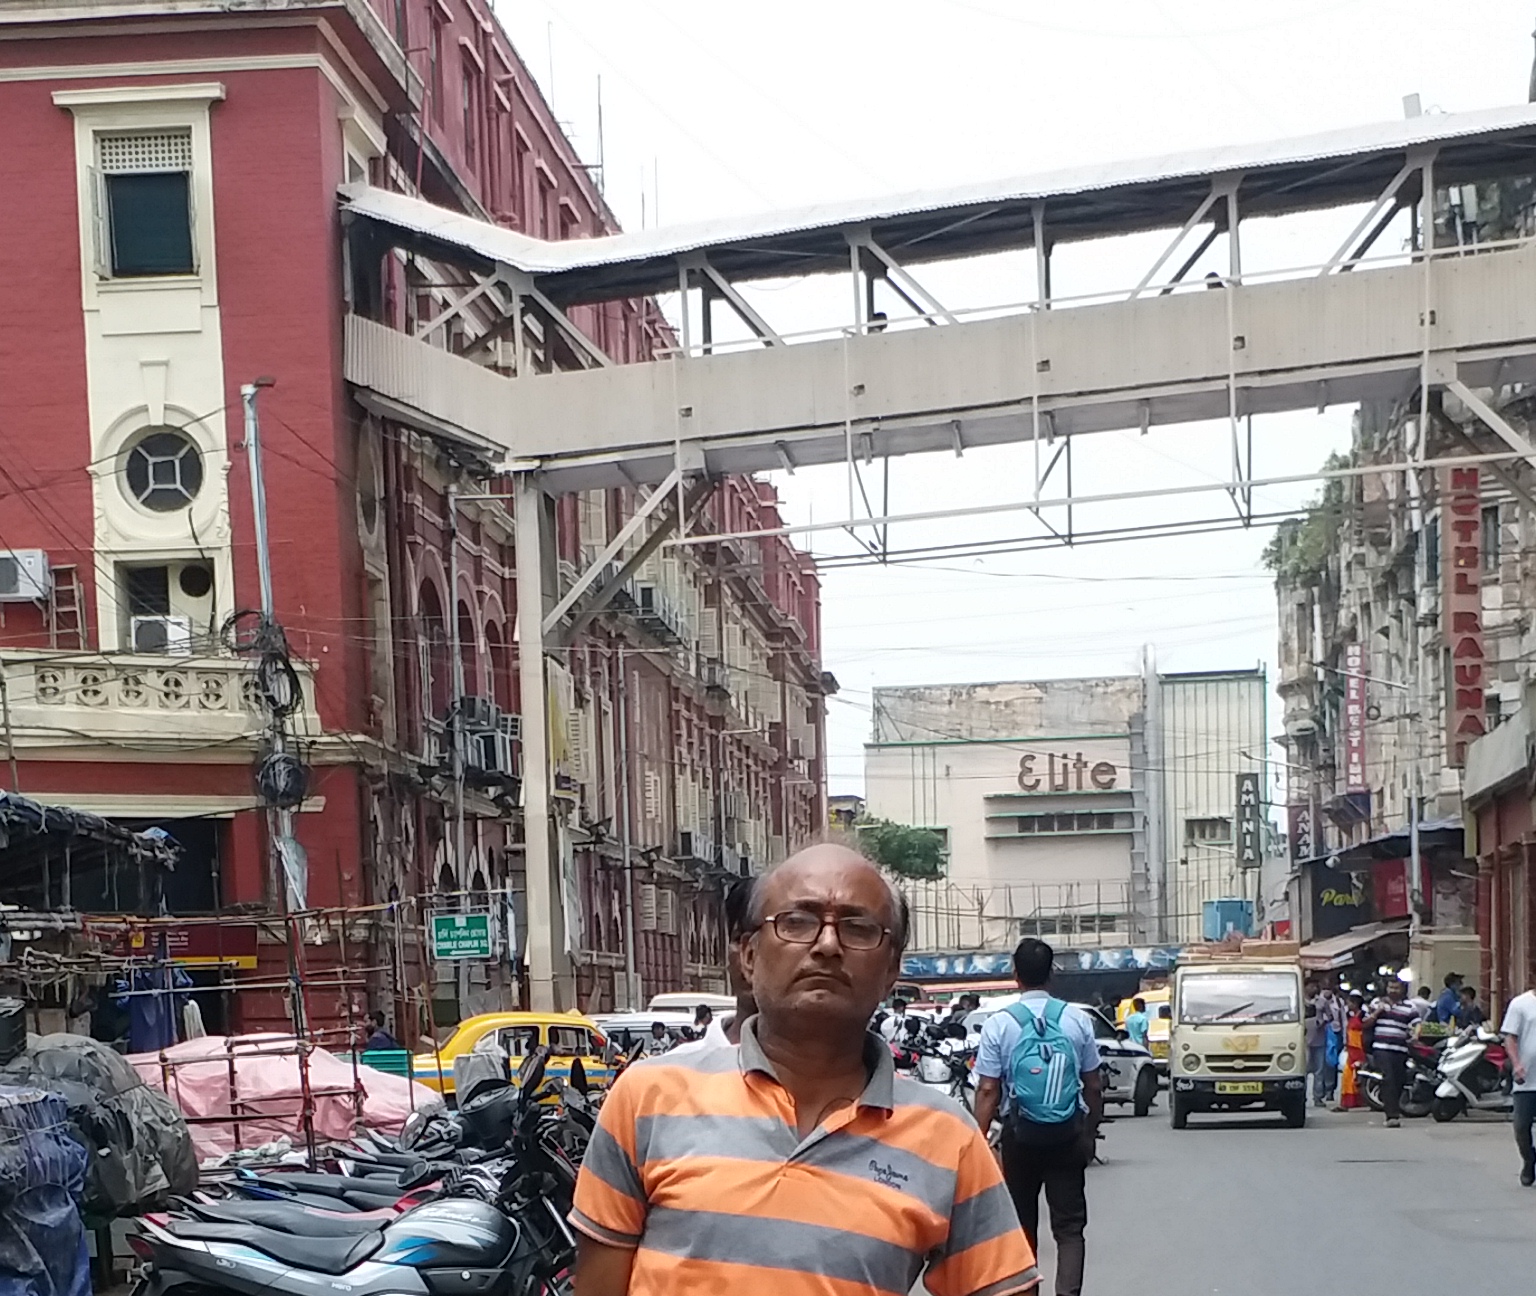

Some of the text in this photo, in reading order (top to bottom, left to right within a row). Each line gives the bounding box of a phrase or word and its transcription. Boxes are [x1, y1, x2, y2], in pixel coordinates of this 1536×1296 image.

[1451, 468, 1480, 595] HOTEL
[1347, 645, 1361, 700] HOTEL
[1347, 704, 1361, 747] BEST
[1018, 752, 1117, 792] Elite
[1241, 779, 1255, 861] AMINIA
